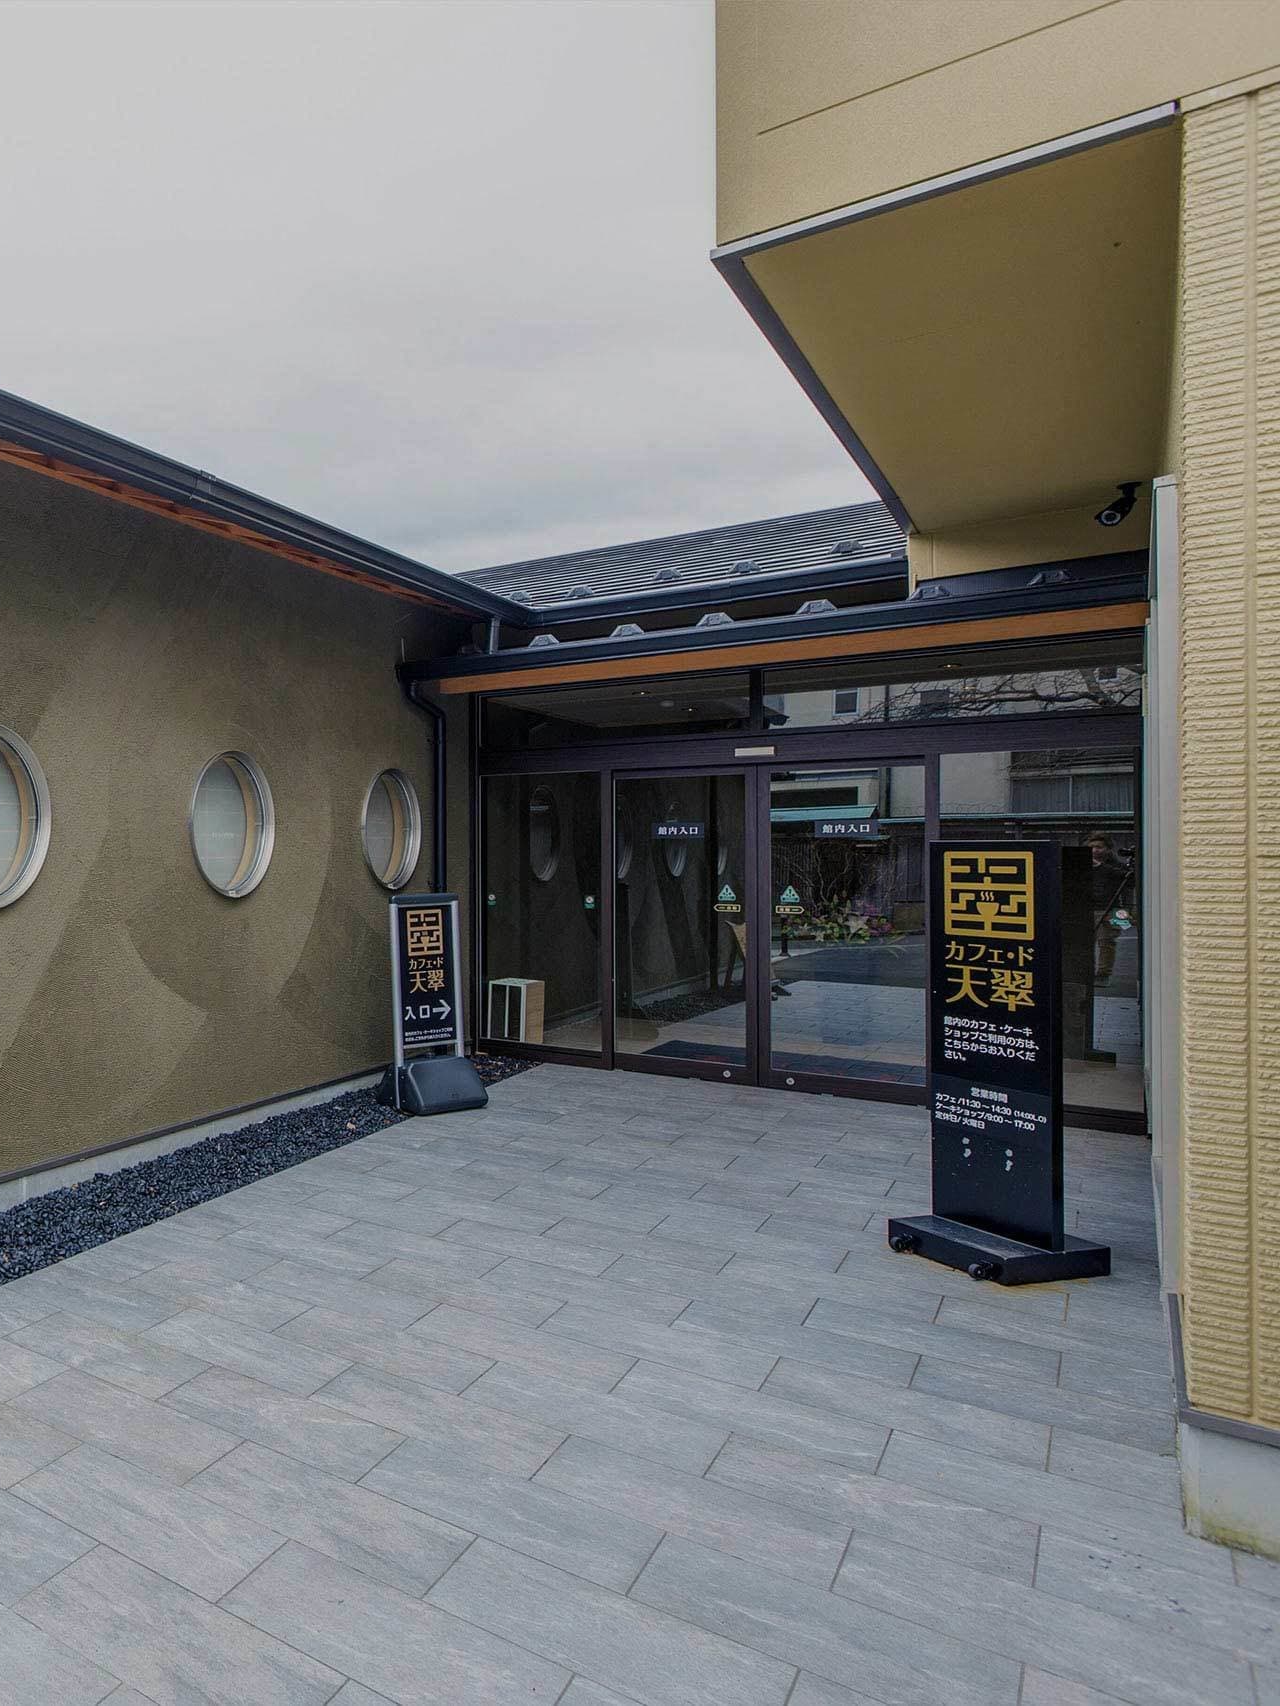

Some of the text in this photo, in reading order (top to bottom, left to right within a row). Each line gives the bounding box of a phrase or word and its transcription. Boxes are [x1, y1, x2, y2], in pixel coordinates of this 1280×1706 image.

[658, 826, 698, 835] 館内入口
[822, 823, 870, 834] 館内入口
[945, 941, 1035, 967] カフェ・ド
[408, 957, 444, 970] カフェ・ド
[409, 970, 445, 993] 天翠
[945, 964, 1036, 1012] 天翠
[404, 1005, 430, 1020] 入口
[944, 1038, 1036, 1061] こちらからお入りくだ
[944, 1049, 967, 1061] さい。
[970, 1086, 1008, 1104] 営業時間
